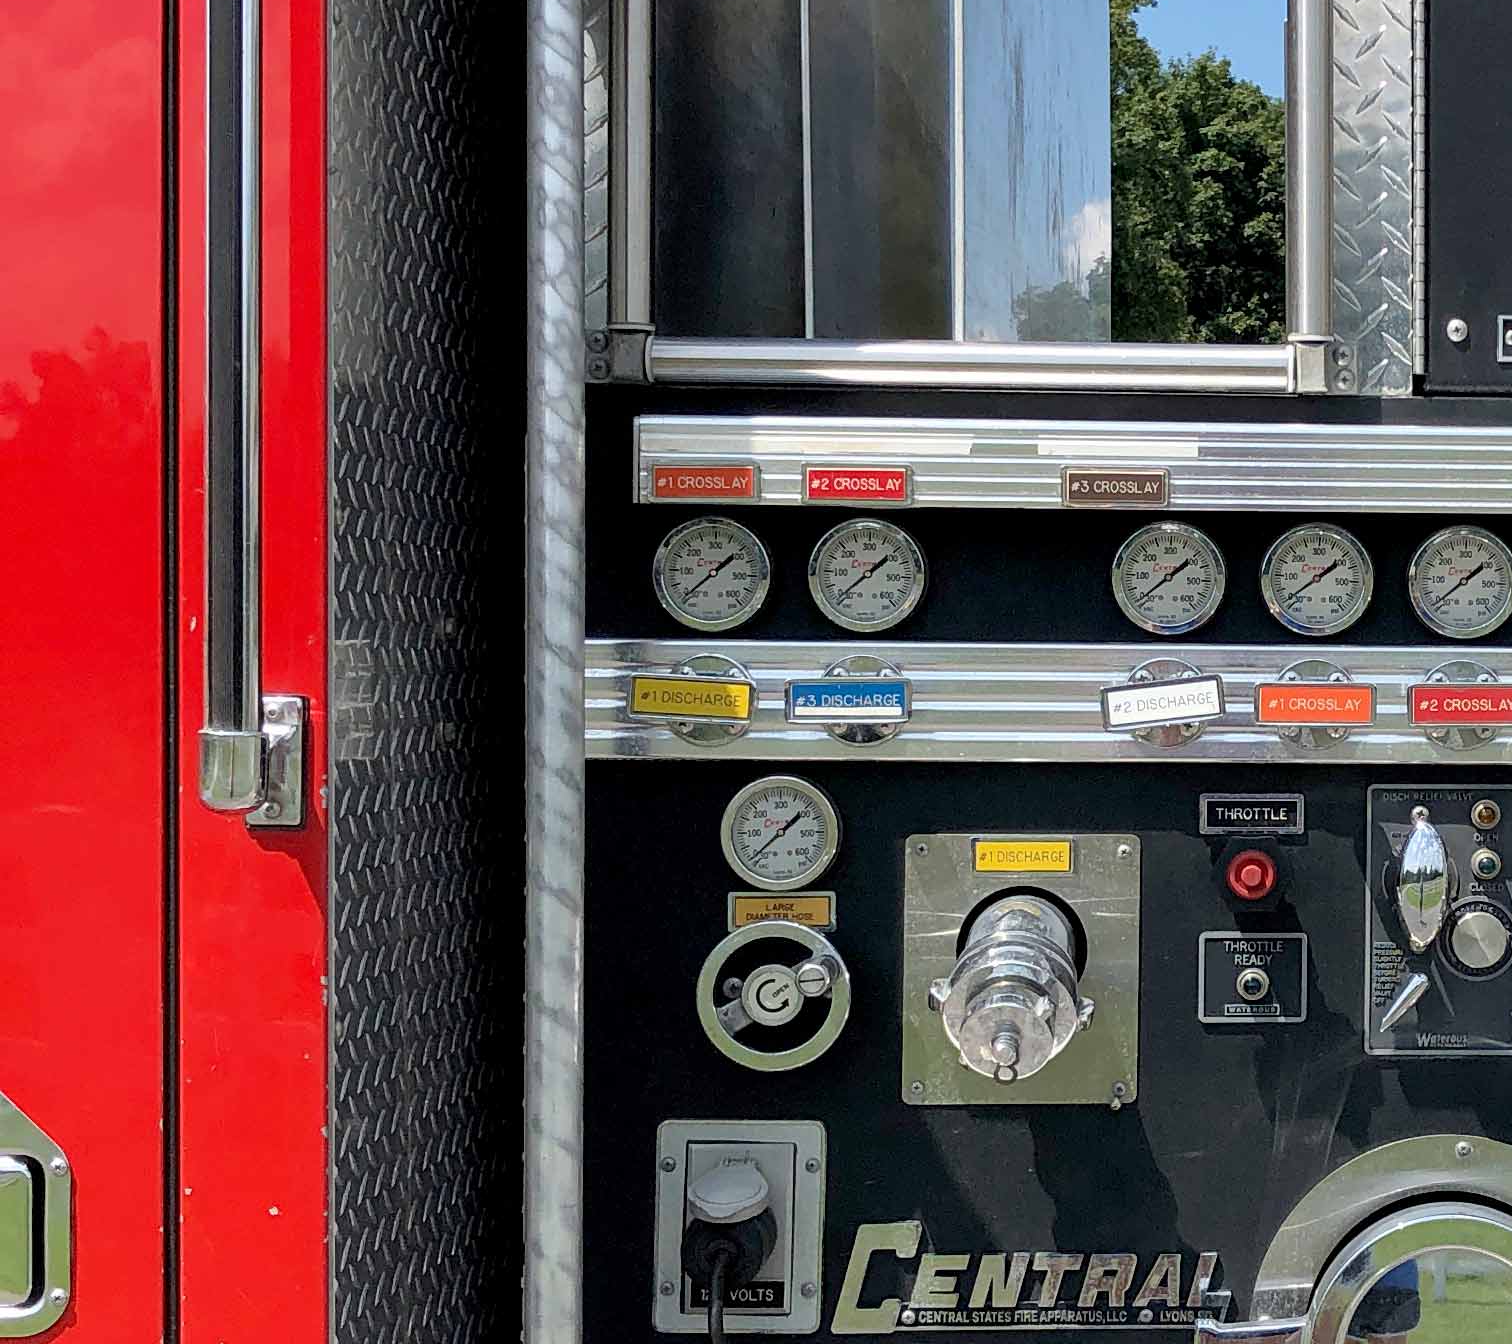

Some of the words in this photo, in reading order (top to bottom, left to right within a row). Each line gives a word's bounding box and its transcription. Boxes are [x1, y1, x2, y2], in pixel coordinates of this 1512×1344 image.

[657, 477, 674, 488] #1
[677, 477, 748, 489] CROSSLAY
[811, 478, 829, 490] #2
[834, 478, 901, 491] CROSSLAY
[1071, 481, 1090, 493] #3
[1094, 481, 1159, 494] CROSSLAY
[1187, 577, 1200, 585] 500
[640, 690, 658, 703] #1
[663, 691, 741, 707] DISCHARGE
[797, 695, 816, 707] #3
[821, 694, 901, 707] DISCHARGE
[1113, 702, 1132, 713] #2
[1136, 691, 1214, 712] DISCHARGE
[1268, 699, 1285, 710] #1
[1289, 698, 1362, 712] CROSSLAY
[1419, 699, 1438, 711] #2
[1383, 792, 1409, 801] DISCH
[1216, 808, 1288, 821] THROTTLE
[1474, 833, 1499, 843] OPEN
[979, 851, 994, 863] #1
[996, 851, 1065, 863] DISCHARGE
[1469, 882, 1505, 892] CLOSED
[765, 903, 795, 911] LARGE
[746, 912, 788, 921] DIAMETER
[791, 912, 815, 921] HOSE
[1223, 941, 1284, 953] THROTTLE
[1234, 954, 1273, 966] READY
[772, 982, 790, 998] OPEN
[831, 1220, 1232, 1334] CENTRAL
[729, 1288, 774, 1302] VOLTS
[918, 1311, 969, 1324] CENTRAL
[972, 1311, 1012, 1324] STATES
[1014, 1311, 1038, 1323] FIRE
[1160, 1310, 1195, 1323] LYONS
